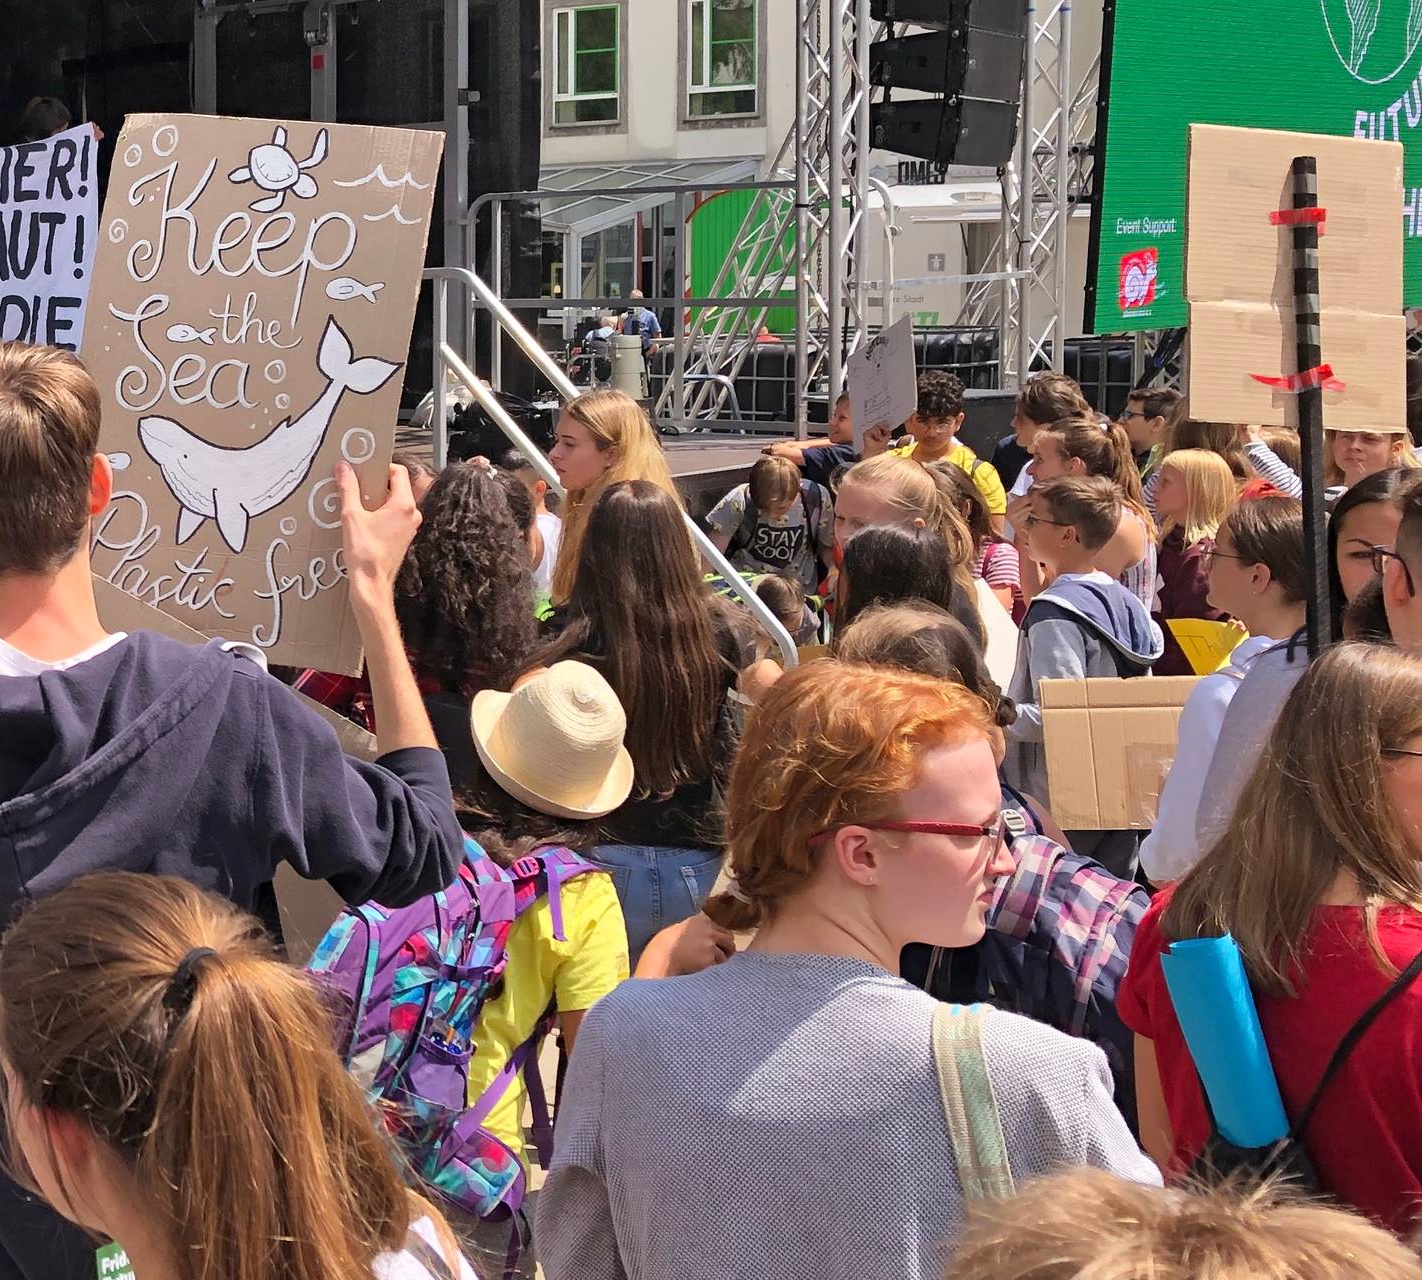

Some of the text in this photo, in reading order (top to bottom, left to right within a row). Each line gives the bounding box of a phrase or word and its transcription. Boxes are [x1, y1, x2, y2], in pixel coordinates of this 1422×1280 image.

[1354, 64, 1422, 142] FUTU
[125, 155, 358, 330] Keep
[1116, 218, 1140, 234] Event
[108, 293, 259, 412] Sea
[209, 291, 302, 349] the
[90, 490, 236, 618] Plastic
[757, 527, 802, 547] STAY
[101, 1250, 131, 1275] Frid
